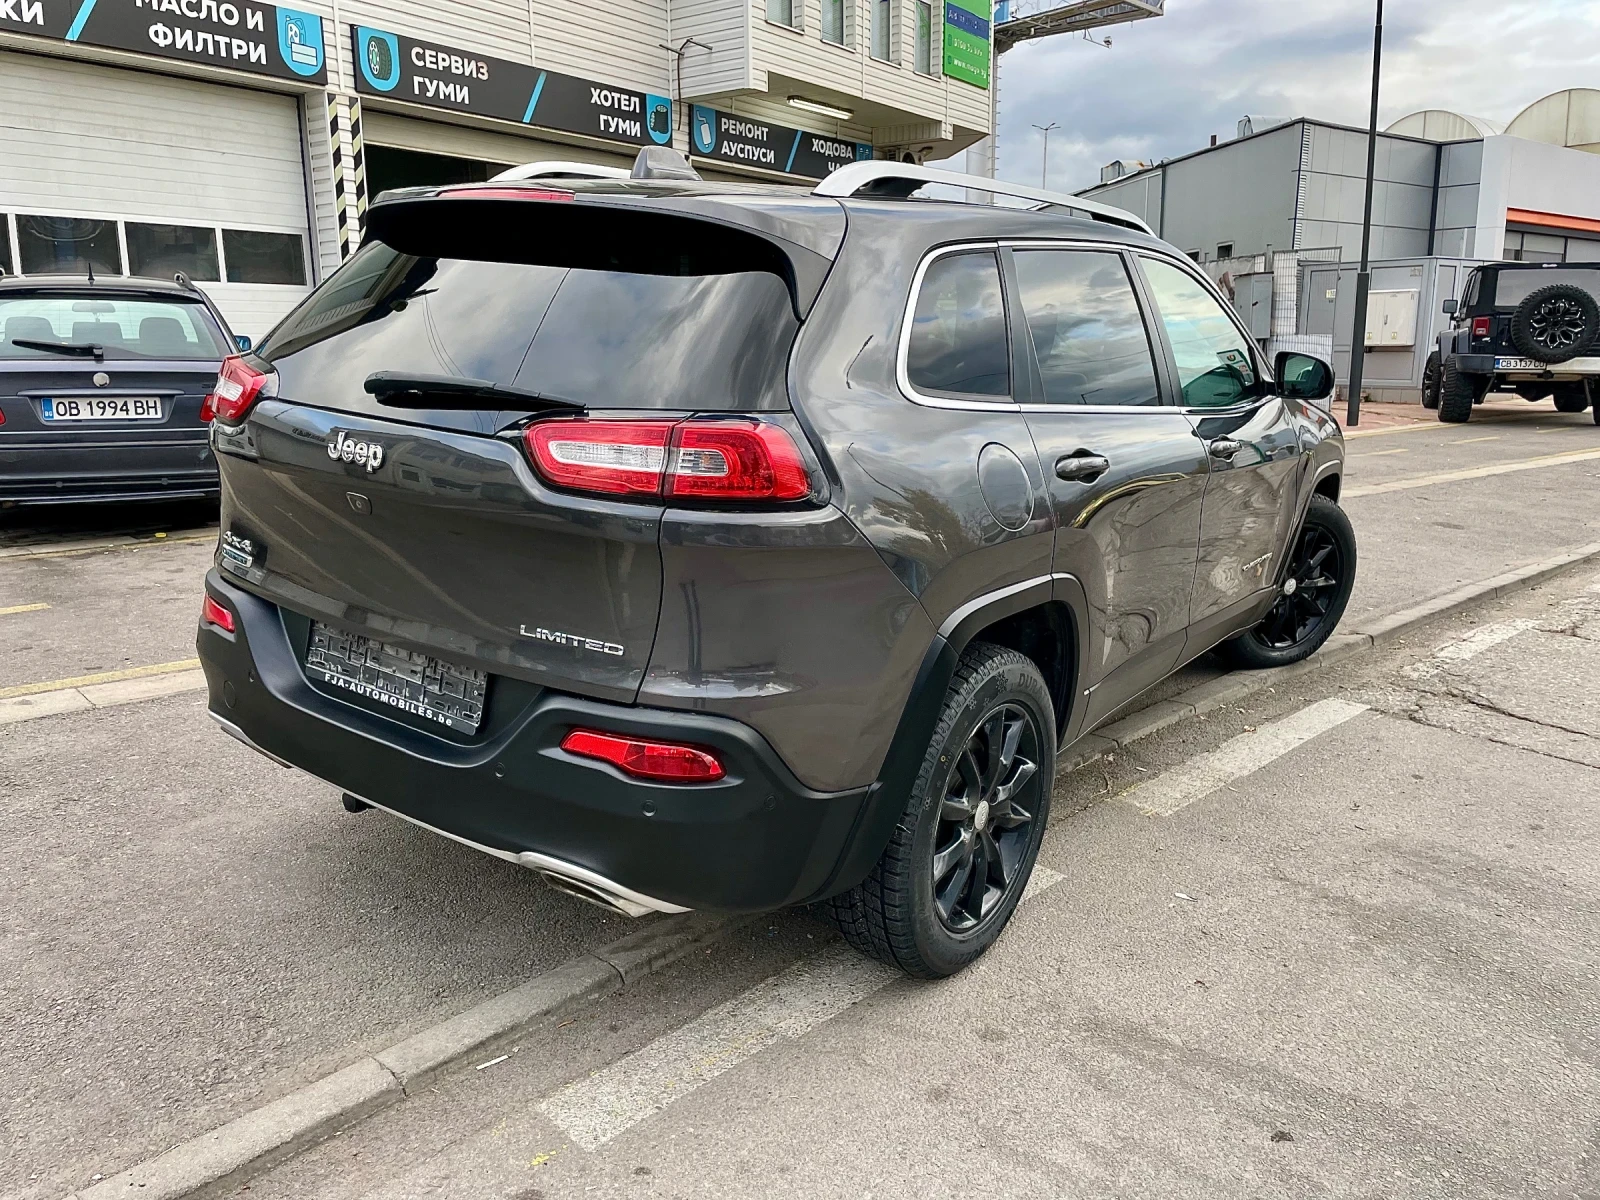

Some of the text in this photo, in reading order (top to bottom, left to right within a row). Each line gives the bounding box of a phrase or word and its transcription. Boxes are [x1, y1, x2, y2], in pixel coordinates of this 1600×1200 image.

[246, 8, 264, 32] И
[149, 22, 267, 65] ФИЛТРИ
[411, 46, 489, 80] СЕРВИЗ
[413, 76, 470, 105] ГУМИ
[590, 87, 640, 113] ХОТЕЛ
[600, 115, 641, 138] ГУМИ
[721, 118, 769, 142] РЕМОНТ
[721, 140, 775, 164] АУСПУСИ
[812, 138, 853, 159] ХОДОВА
[55, 400, 158, 417] OB 1994 BH
[327, 430, 385, 473] Jeep
[520, 624, 624, 656] LIMITED
[325, 673, 452, 726] FJA-AUTOMOBILES.be
